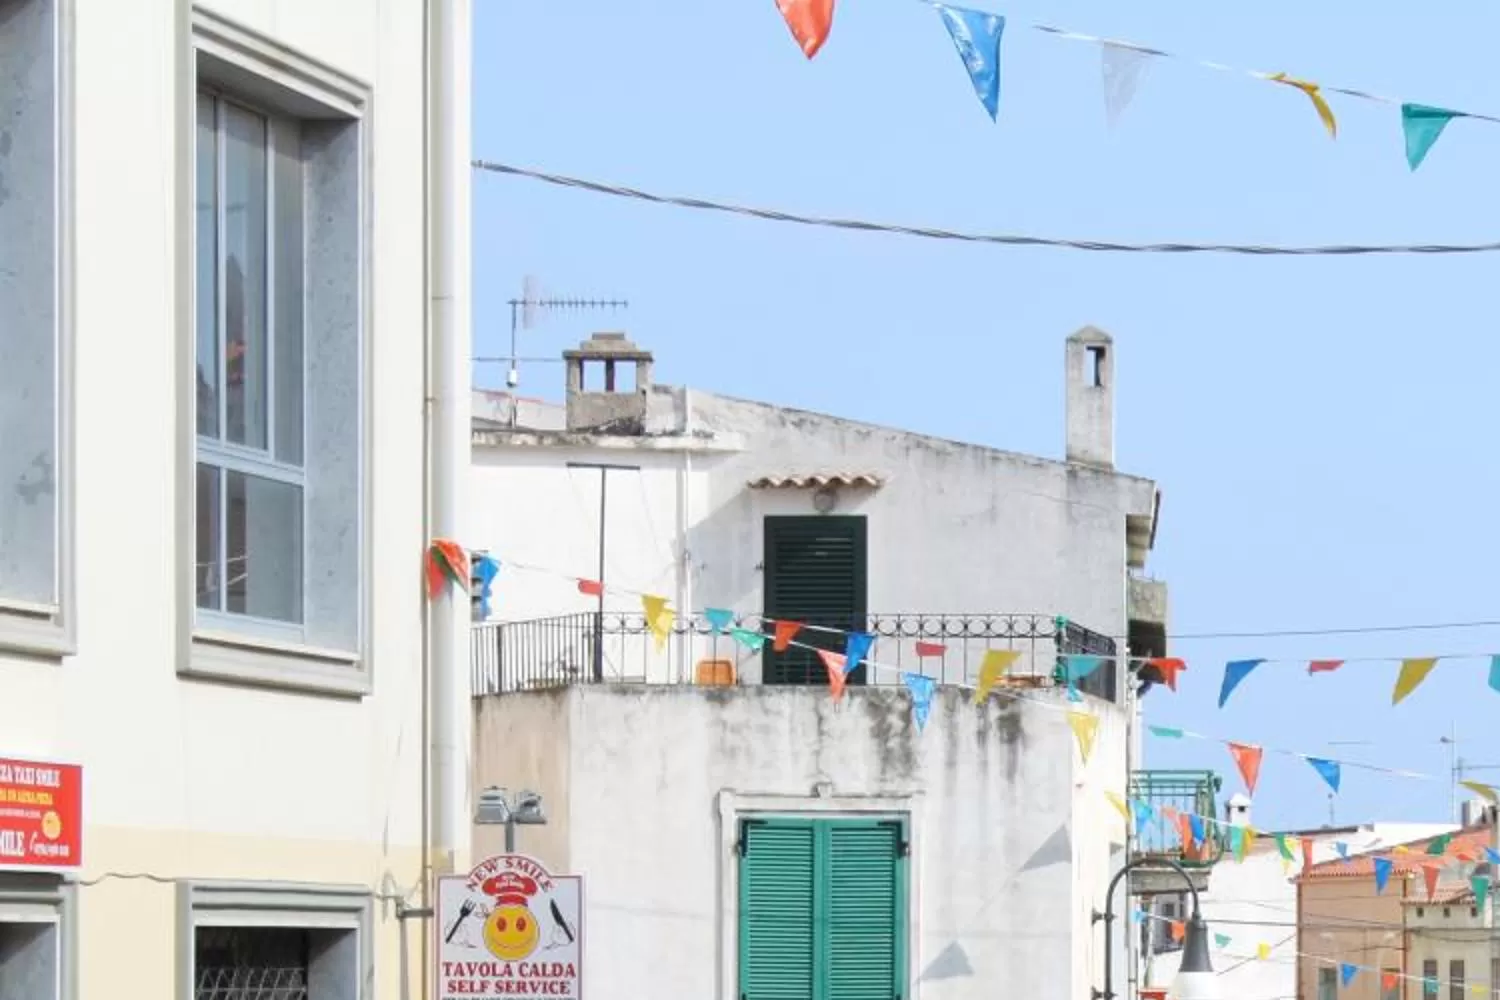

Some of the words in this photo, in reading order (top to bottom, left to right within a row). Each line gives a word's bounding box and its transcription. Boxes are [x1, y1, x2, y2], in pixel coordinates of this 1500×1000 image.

[466, 859, 498, 892] NEW
[505, 857, 555, 893] SMILE
[442, 962, 513, 977] TAVOLA
[518, 962, 576, 978] CALDA
[447, 980, 490, 993] SELF
[494, 980, 571, 994] SERVICE
